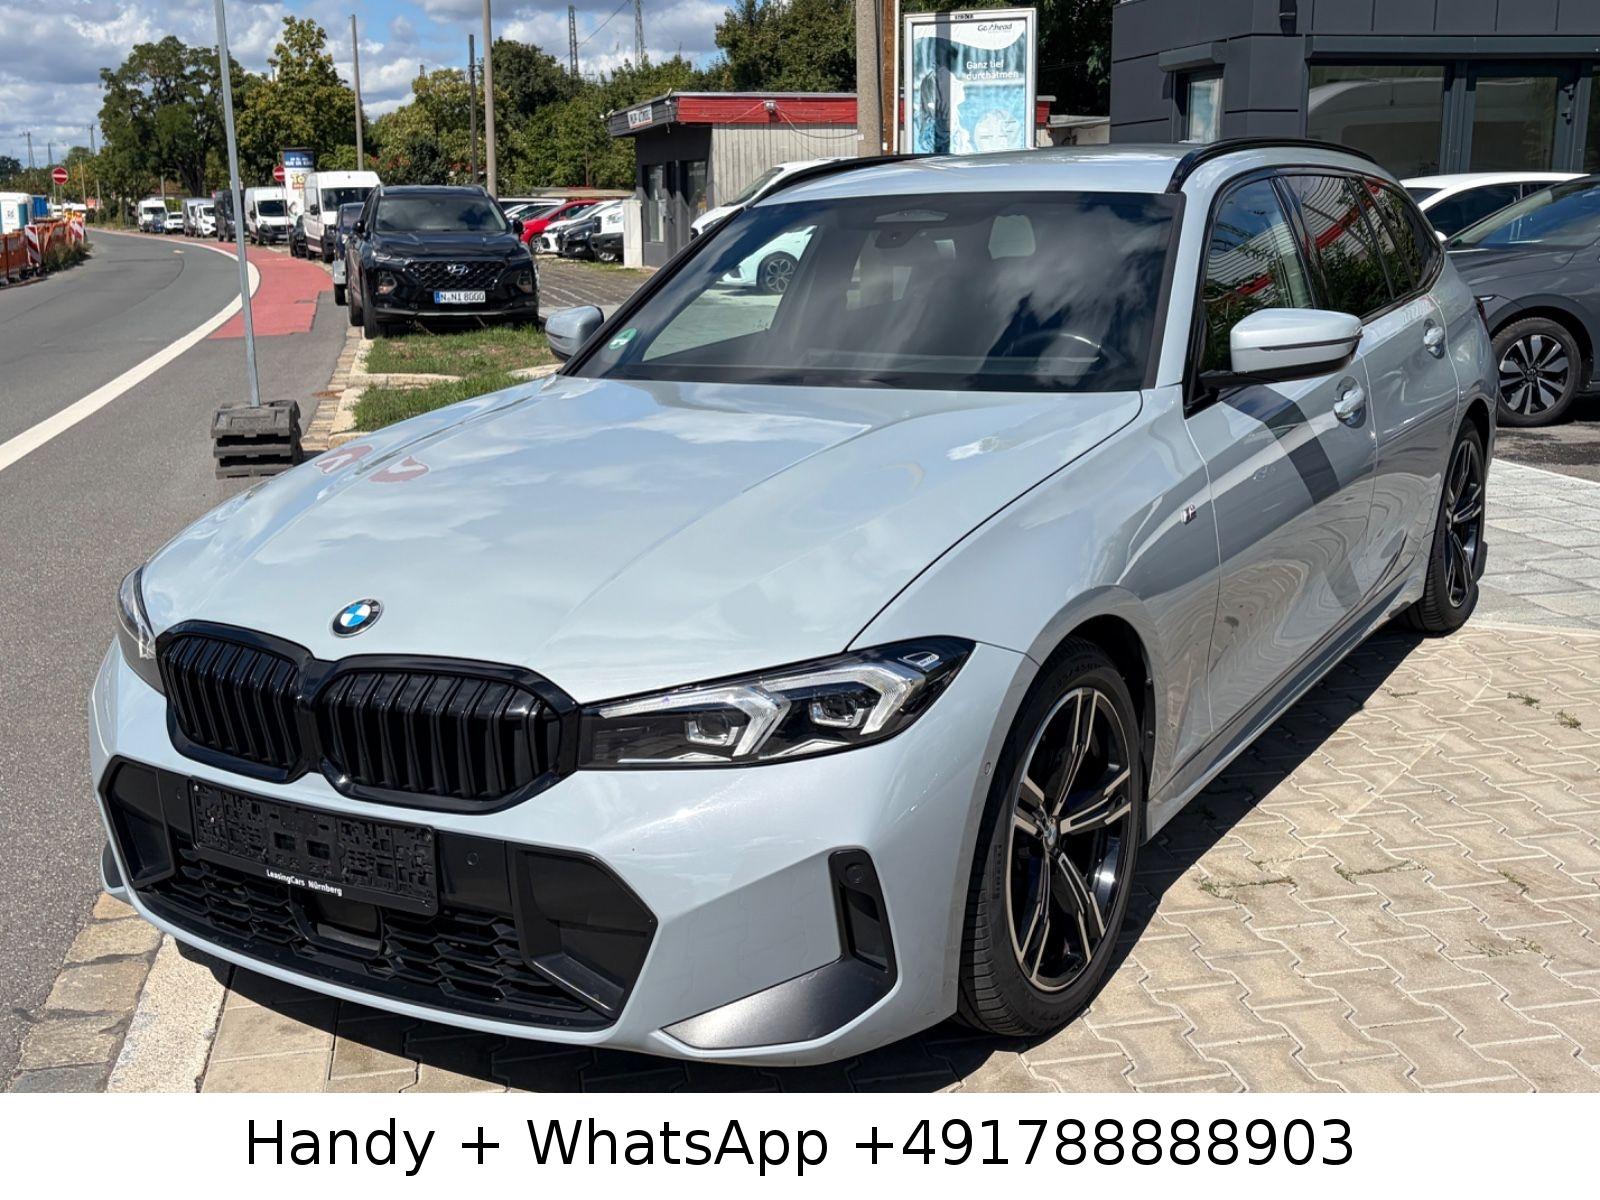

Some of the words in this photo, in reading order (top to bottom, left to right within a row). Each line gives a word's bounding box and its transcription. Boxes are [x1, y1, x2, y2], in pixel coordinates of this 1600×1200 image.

[966, 60, 988, 70] Ganz
[990, 59, 1004, 68] tief
[966, 70, 1019, 80] durchatmen
[266, 868, 305, 886] LeasingCars
[308, 880, 343, 897] Nürnberg
